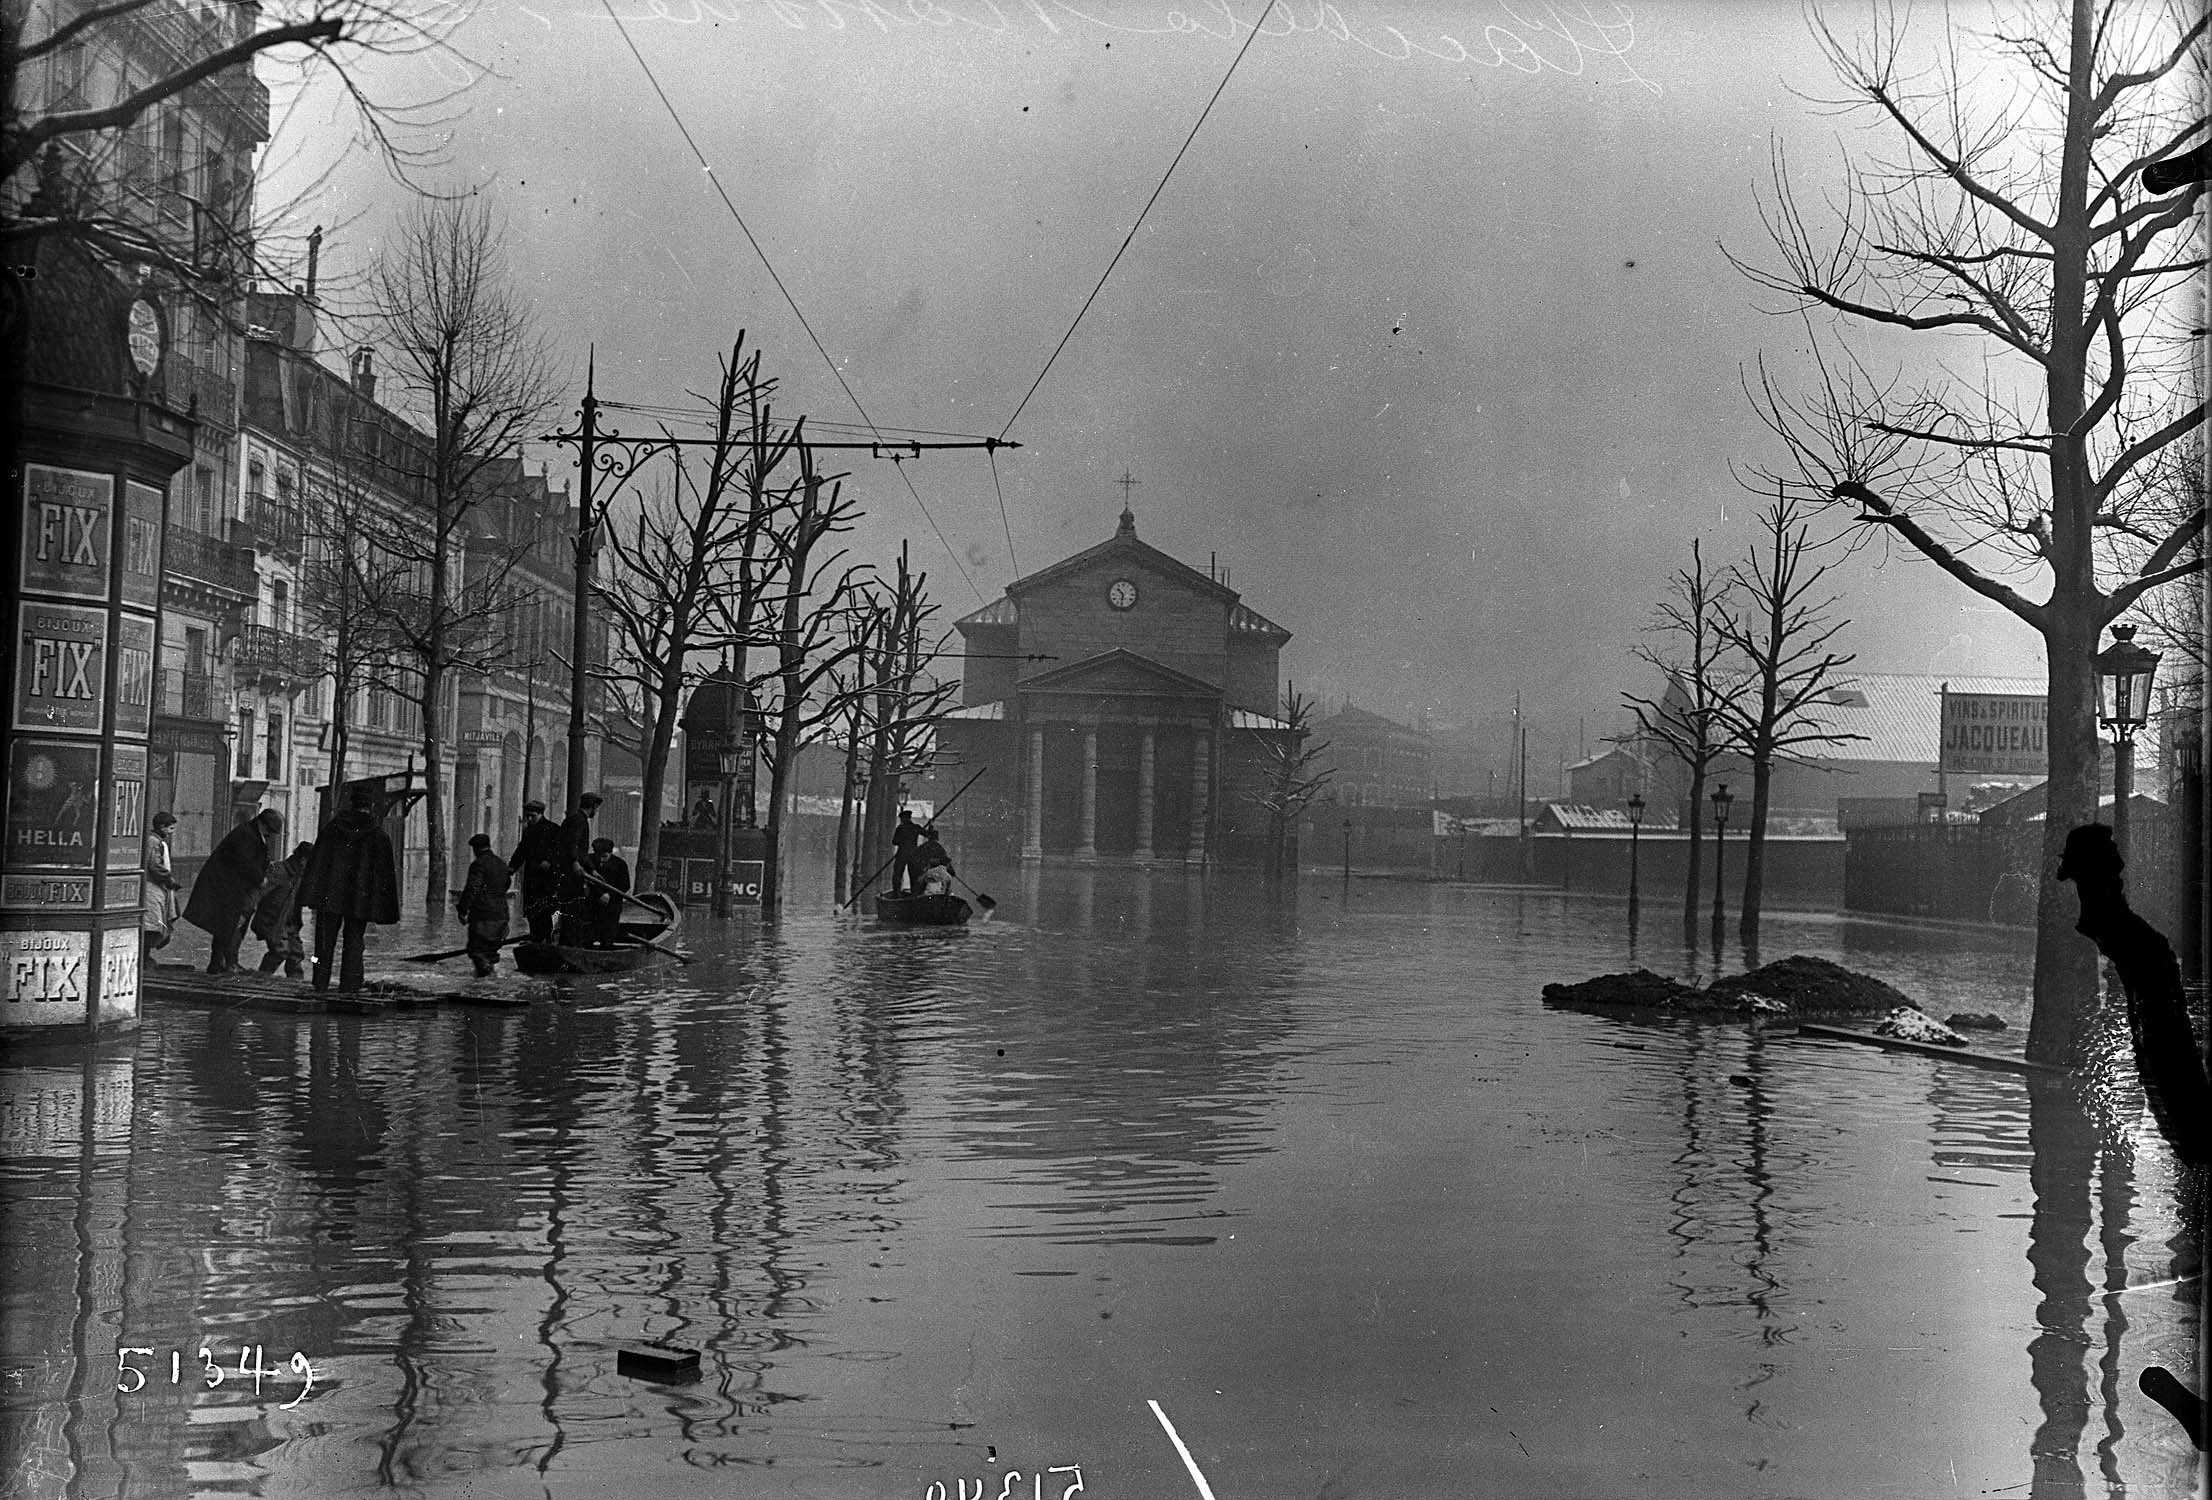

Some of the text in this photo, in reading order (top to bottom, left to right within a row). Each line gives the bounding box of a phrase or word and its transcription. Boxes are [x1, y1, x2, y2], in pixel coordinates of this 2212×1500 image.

[37, 616, 89, 633] BIJOUX
[17, 829, 84, 847] HELLA
[691, 881, 758, 897] BLNC
[20, 937, 71, 951] BIJOUX
